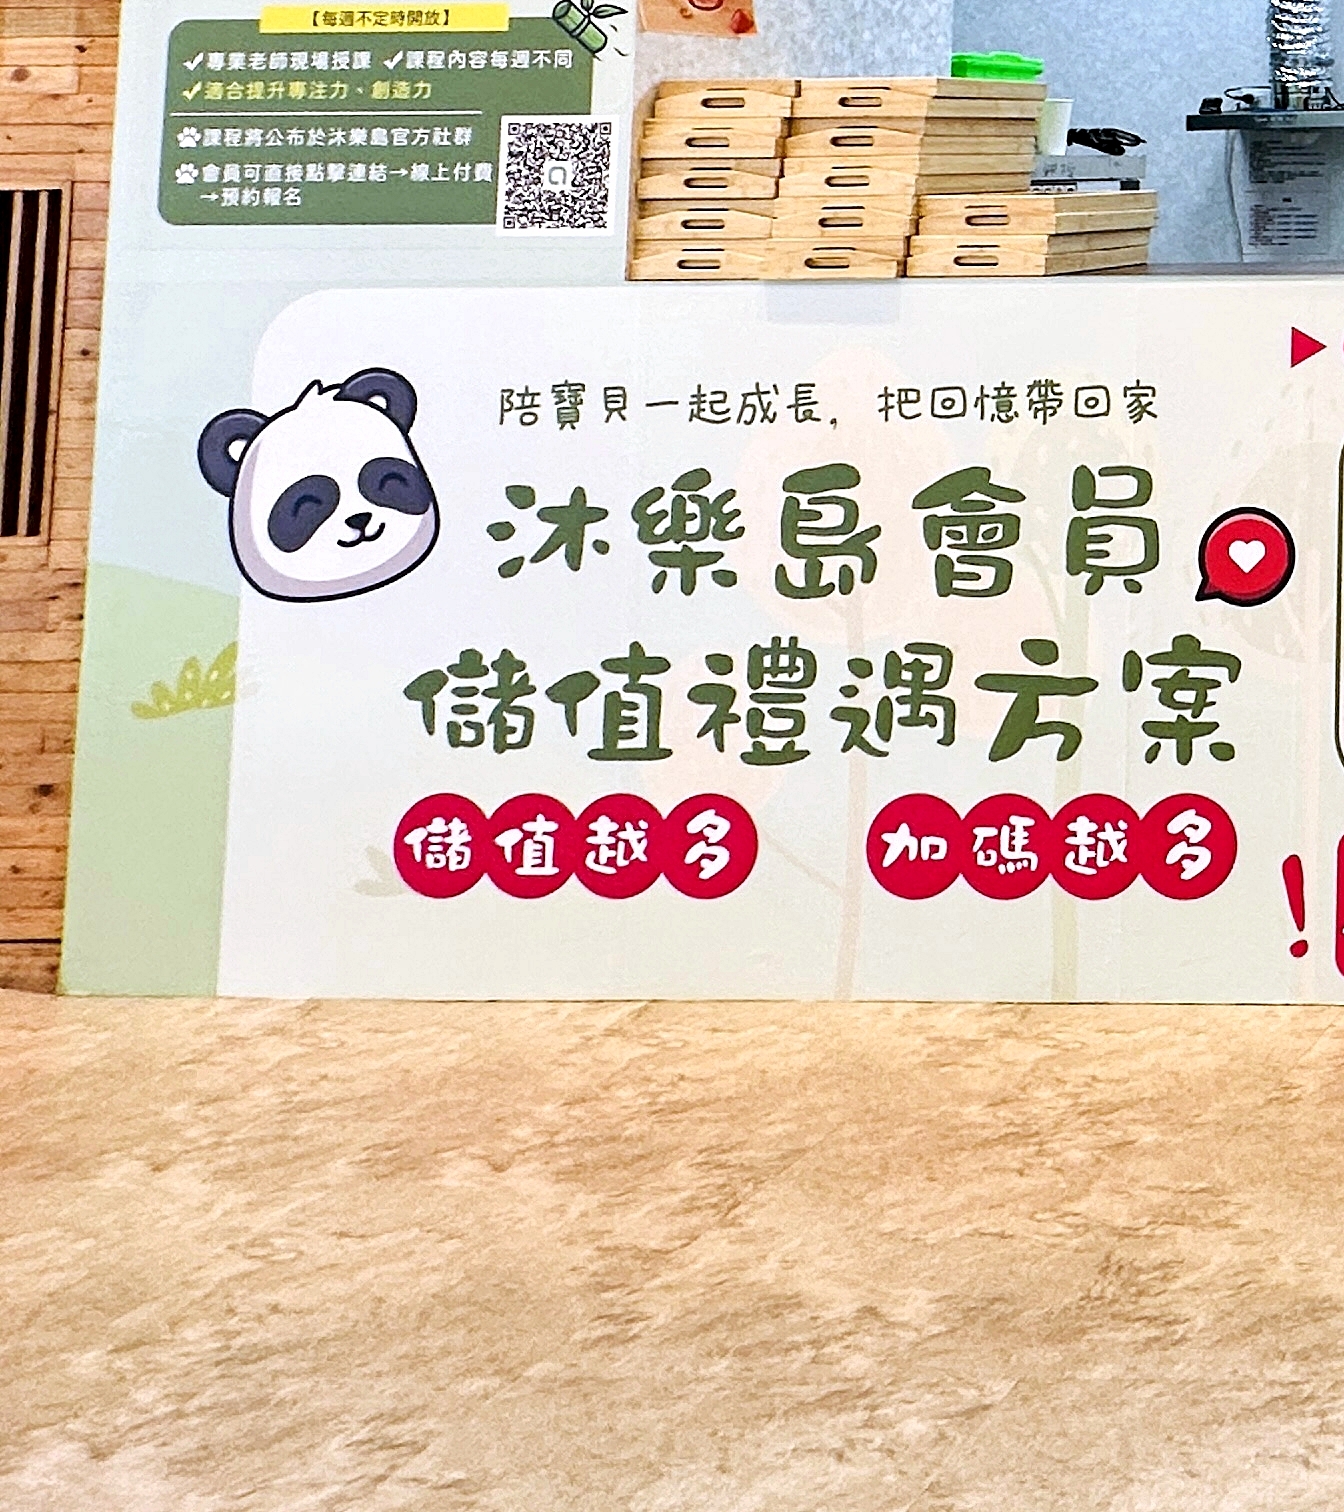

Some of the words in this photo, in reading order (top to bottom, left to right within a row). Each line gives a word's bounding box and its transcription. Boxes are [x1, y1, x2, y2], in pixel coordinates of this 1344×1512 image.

[205, 50, 372, 73] 專業老師現場授課
[405, 49, 573, 71] 課程內容每週不同
[201, 126, 473, 148] 課程將公布於沐樂島官方社群
[487, 464, 1161, 599] 沐樂島會員
[403, 636, 1241, 767] 儲值禮遇方案
[404, 813, 734, 881] 儲值越多
[881, 813, 1215, 881] 加碼越多
